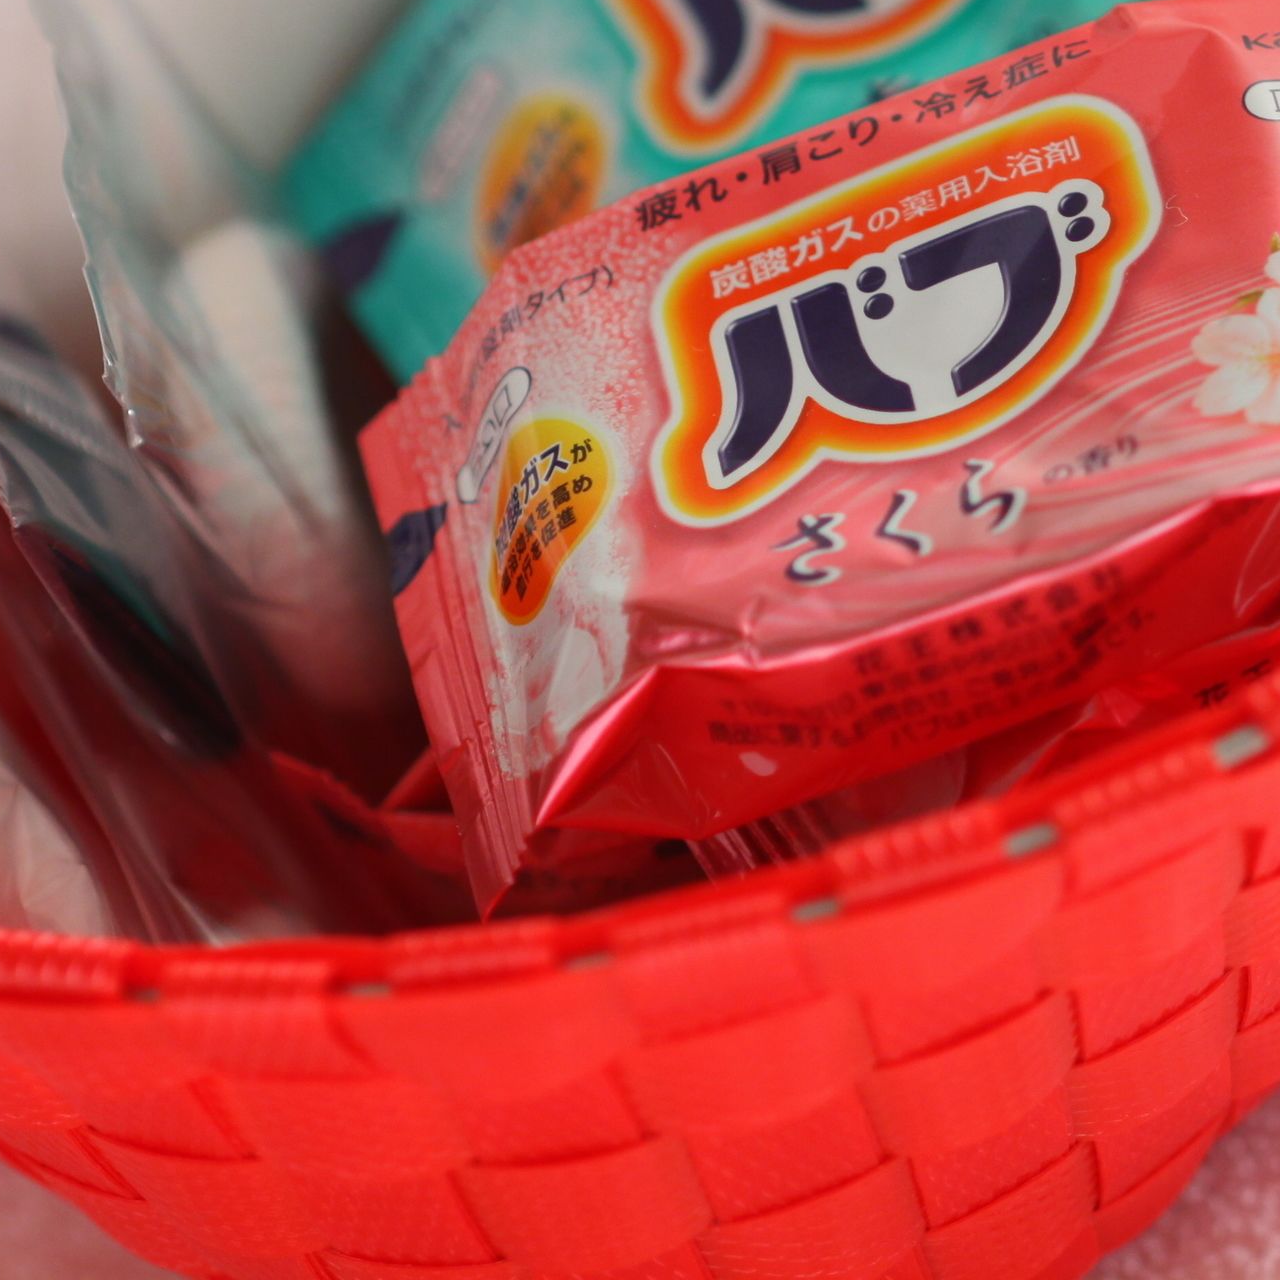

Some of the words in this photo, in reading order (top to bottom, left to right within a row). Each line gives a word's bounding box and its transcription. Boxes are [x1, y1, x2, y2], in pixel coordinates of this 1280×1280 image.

[635, 39, 1092, 232] 疲れ・肩こり・冷え症に
[708, 136, 1082, 299] 炭酸ガスの薬用入浴剤
[717, 191, 1095, 477] バブ
